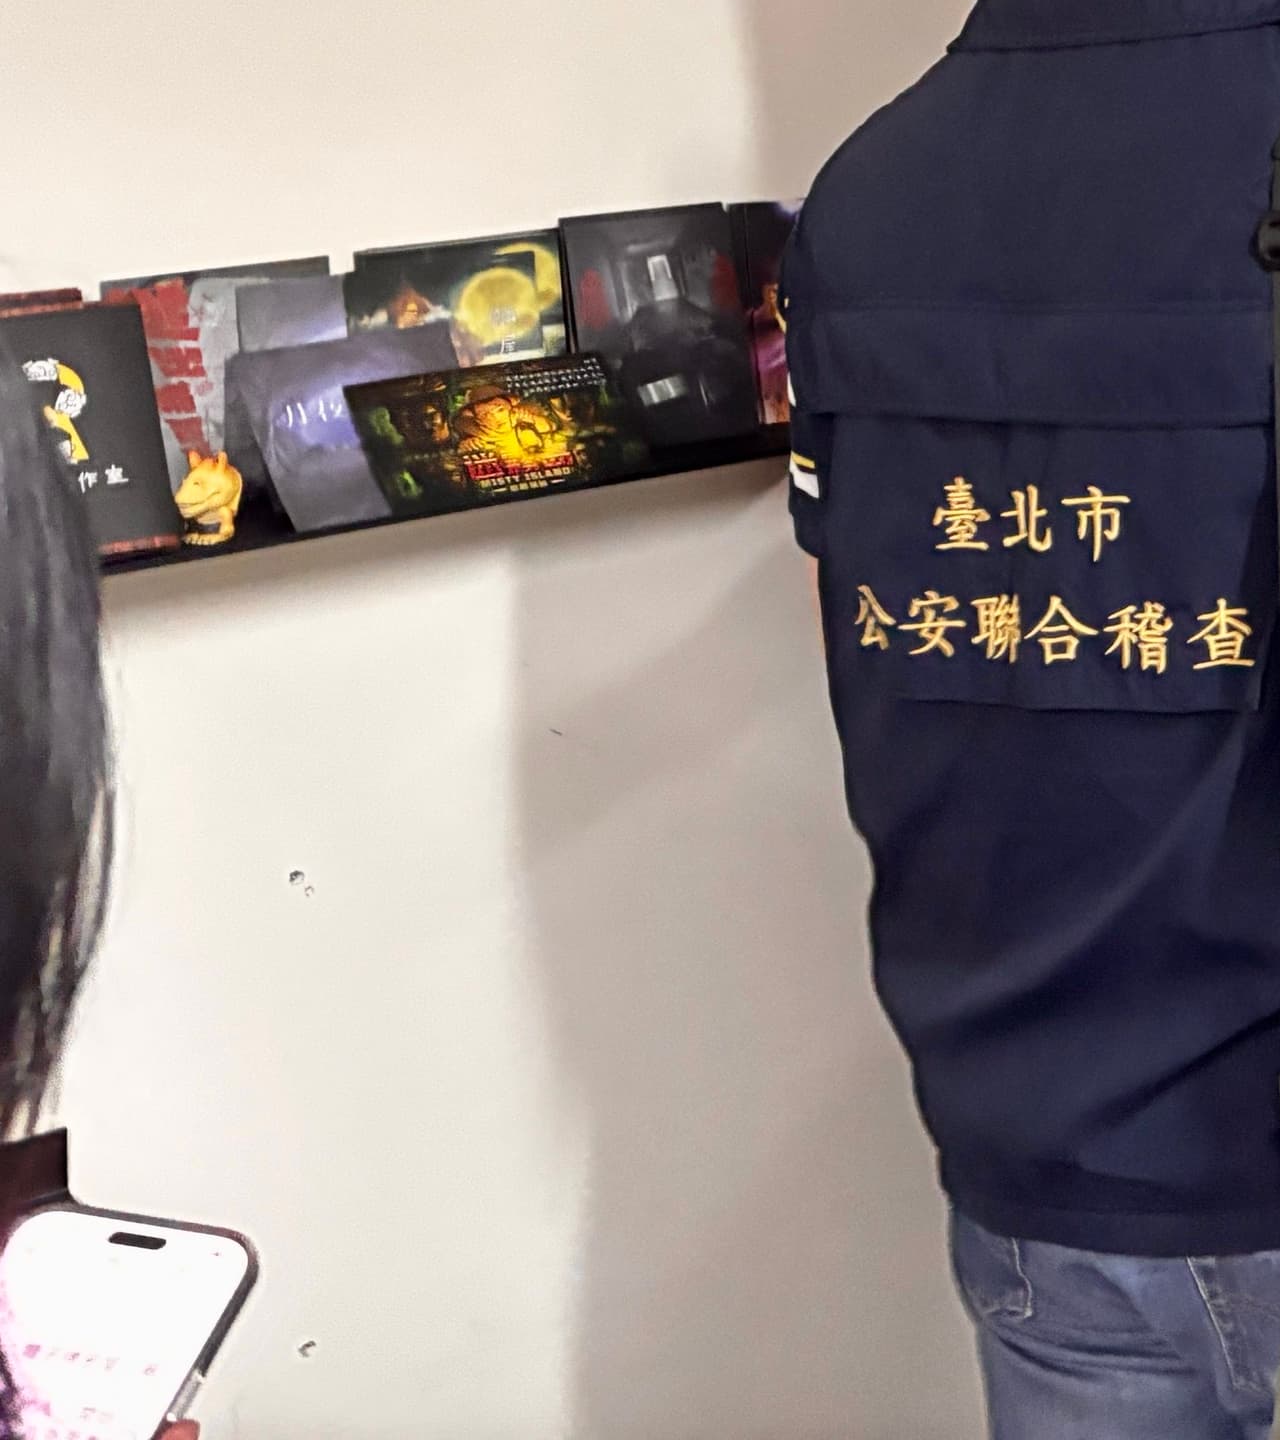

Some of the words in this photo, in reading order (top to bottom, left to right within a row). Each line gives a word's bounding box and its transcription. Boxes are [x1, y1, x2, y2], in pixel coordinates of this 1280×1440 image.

[932, 476, 1131, 562] 臺北市
[855, 584, 1256, 674] 公安聯合稽查
